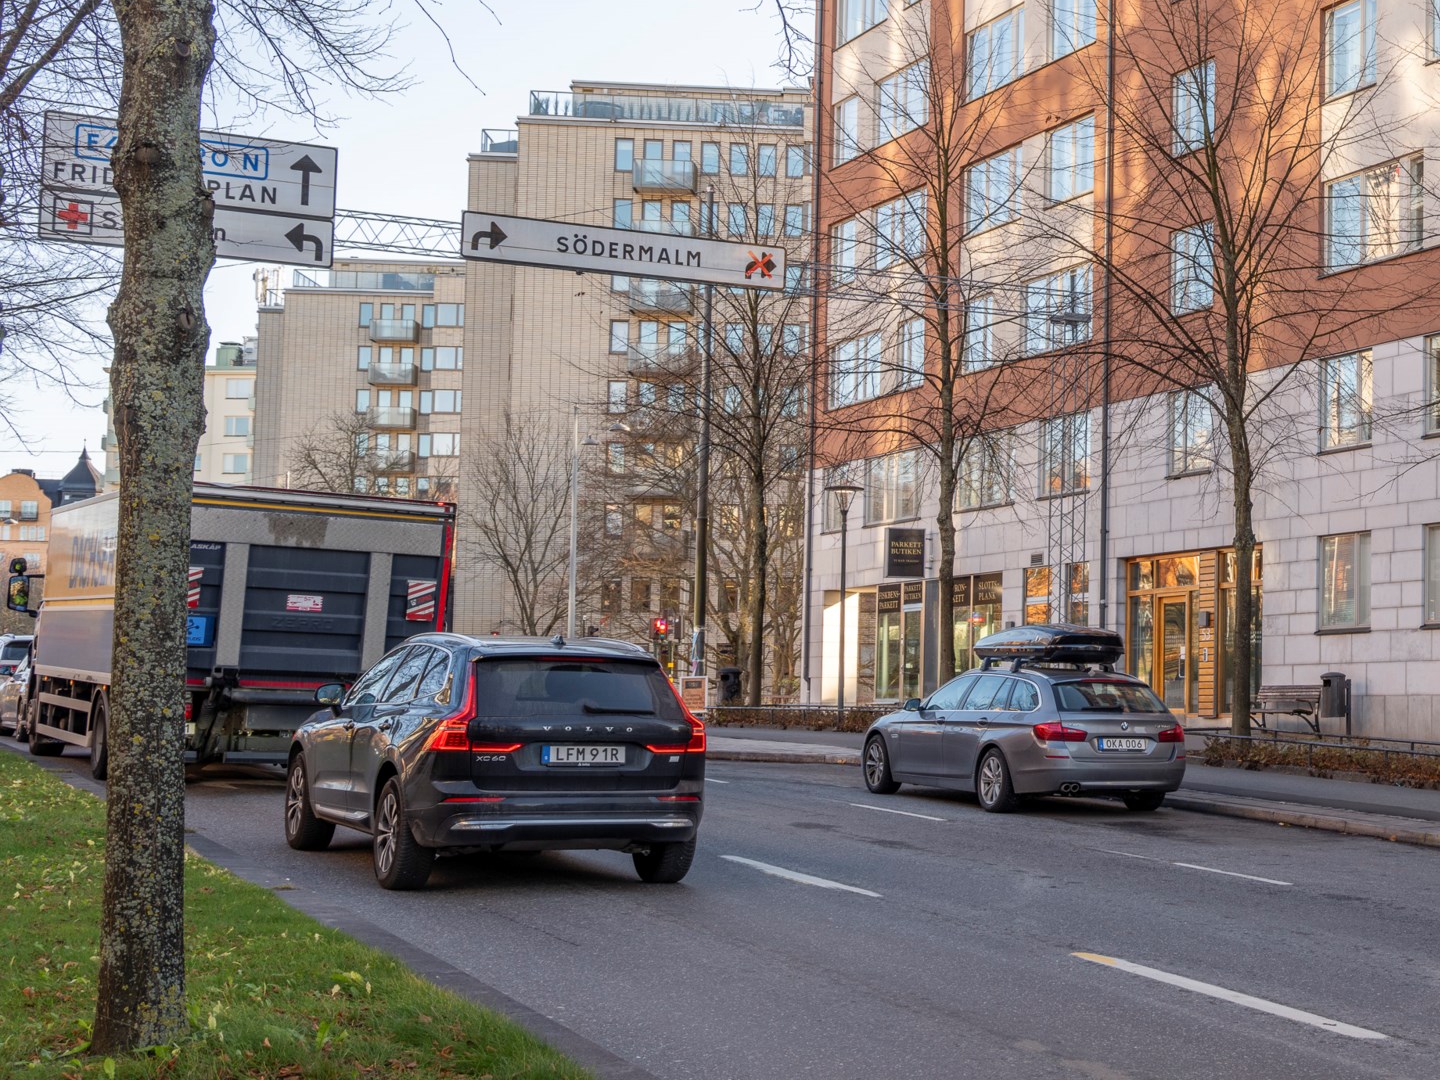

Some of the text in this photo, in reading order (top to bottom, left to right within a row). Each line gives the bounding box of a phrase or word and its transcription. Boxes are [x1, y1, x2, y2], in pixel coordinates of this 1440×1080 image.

[242, 153, 259, 172] N
[556, 233, 701, 268] SÖDERMALM
[978, 592, 996, 601] PLANK
[542, 725, 633, 733] VOLVO
[1106, 740, 1143, 749] OKA 006
[555, 747, 620, 763] LFM 91R
